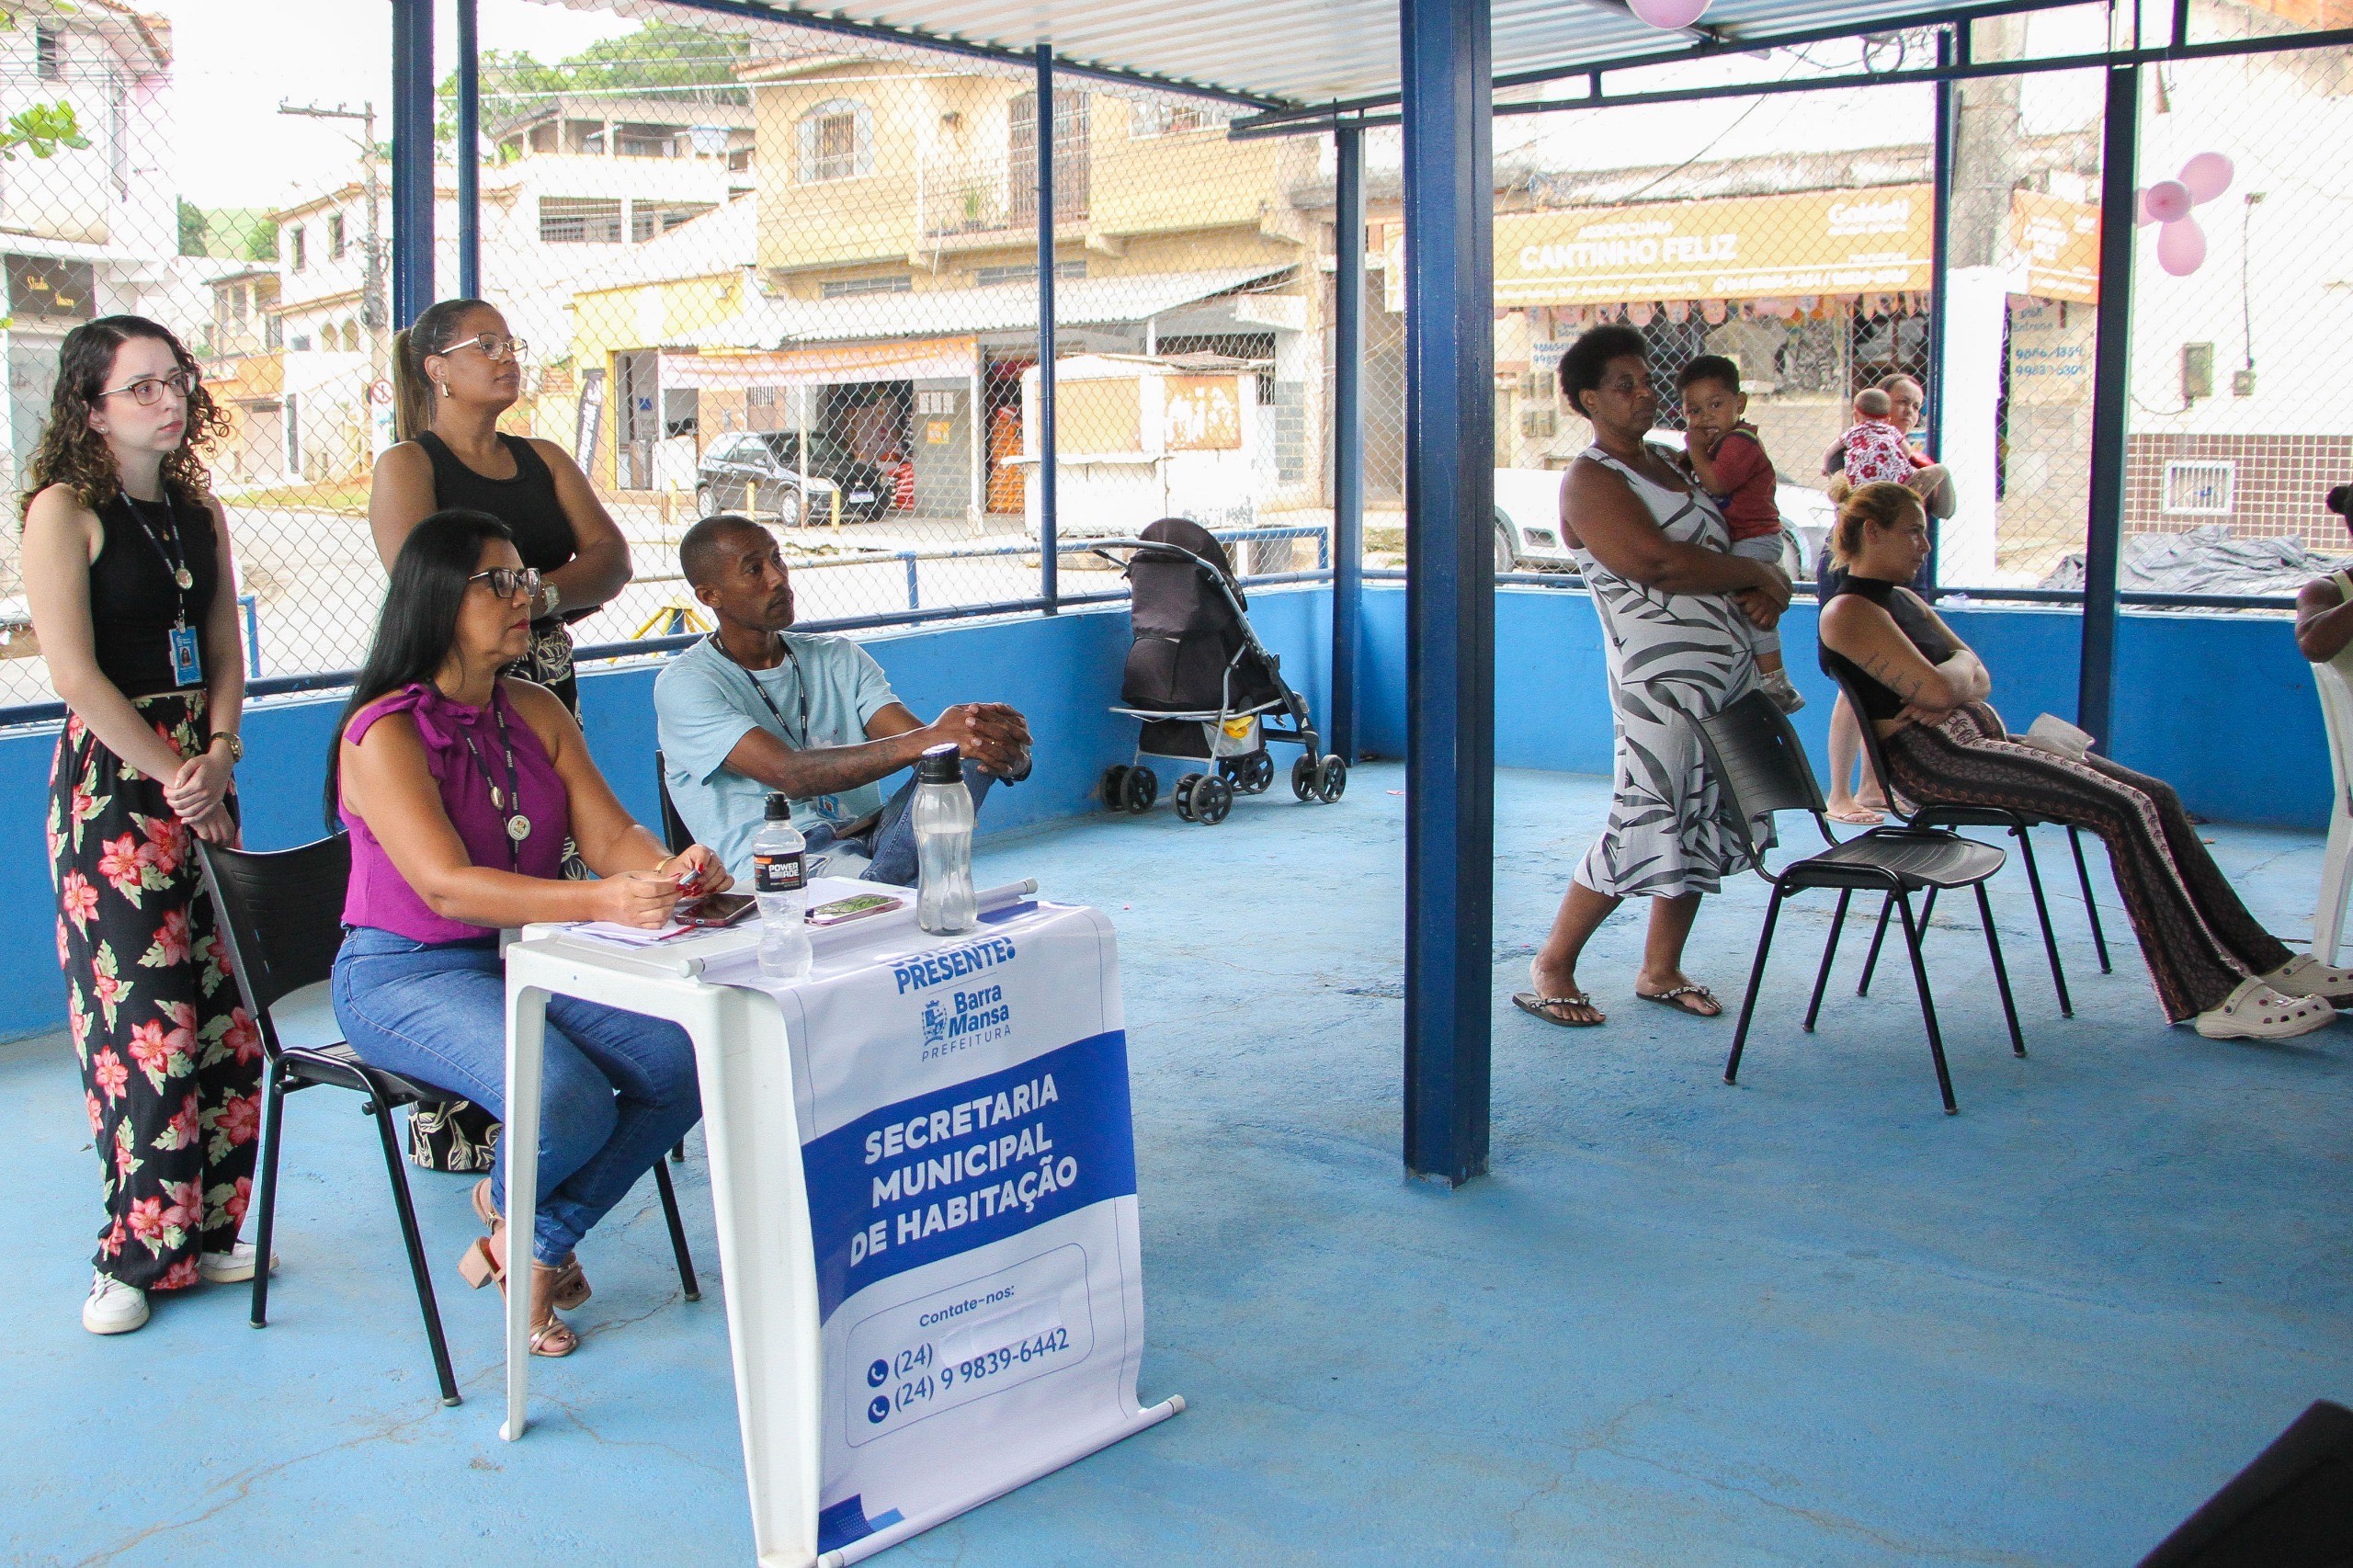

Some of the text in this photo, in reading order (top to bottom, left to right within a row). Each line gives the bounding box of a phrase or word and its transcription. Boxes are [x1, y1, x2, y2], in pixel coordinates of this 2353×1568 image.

[1519, 233, 1737, 270] CANTINHO FELIZ
[768, 862, 799, 872] POWER
[783, 869, 800, 878] ADE
[893, 937, 1016, 994] PRESENTE!
[954, 984, 1002, 1015] Barra
[948, 1004, 1009, 1038] Mansa
[922, 1024, 1011, 1062] PREFEITURA
[864, 1073, 1059, 1165] SECRETARIA
[872, 1121, 1053, 1209] MUNICIPAL
[850, 1153, 1078, 1268] DE HABITAÇÃO
[919, 1285, 1015, 1327] Contate-nos:
[893, 1342, 933, 1380] (24)
[894, 1327, 1070, 1413] (24) 9 9839-6442
